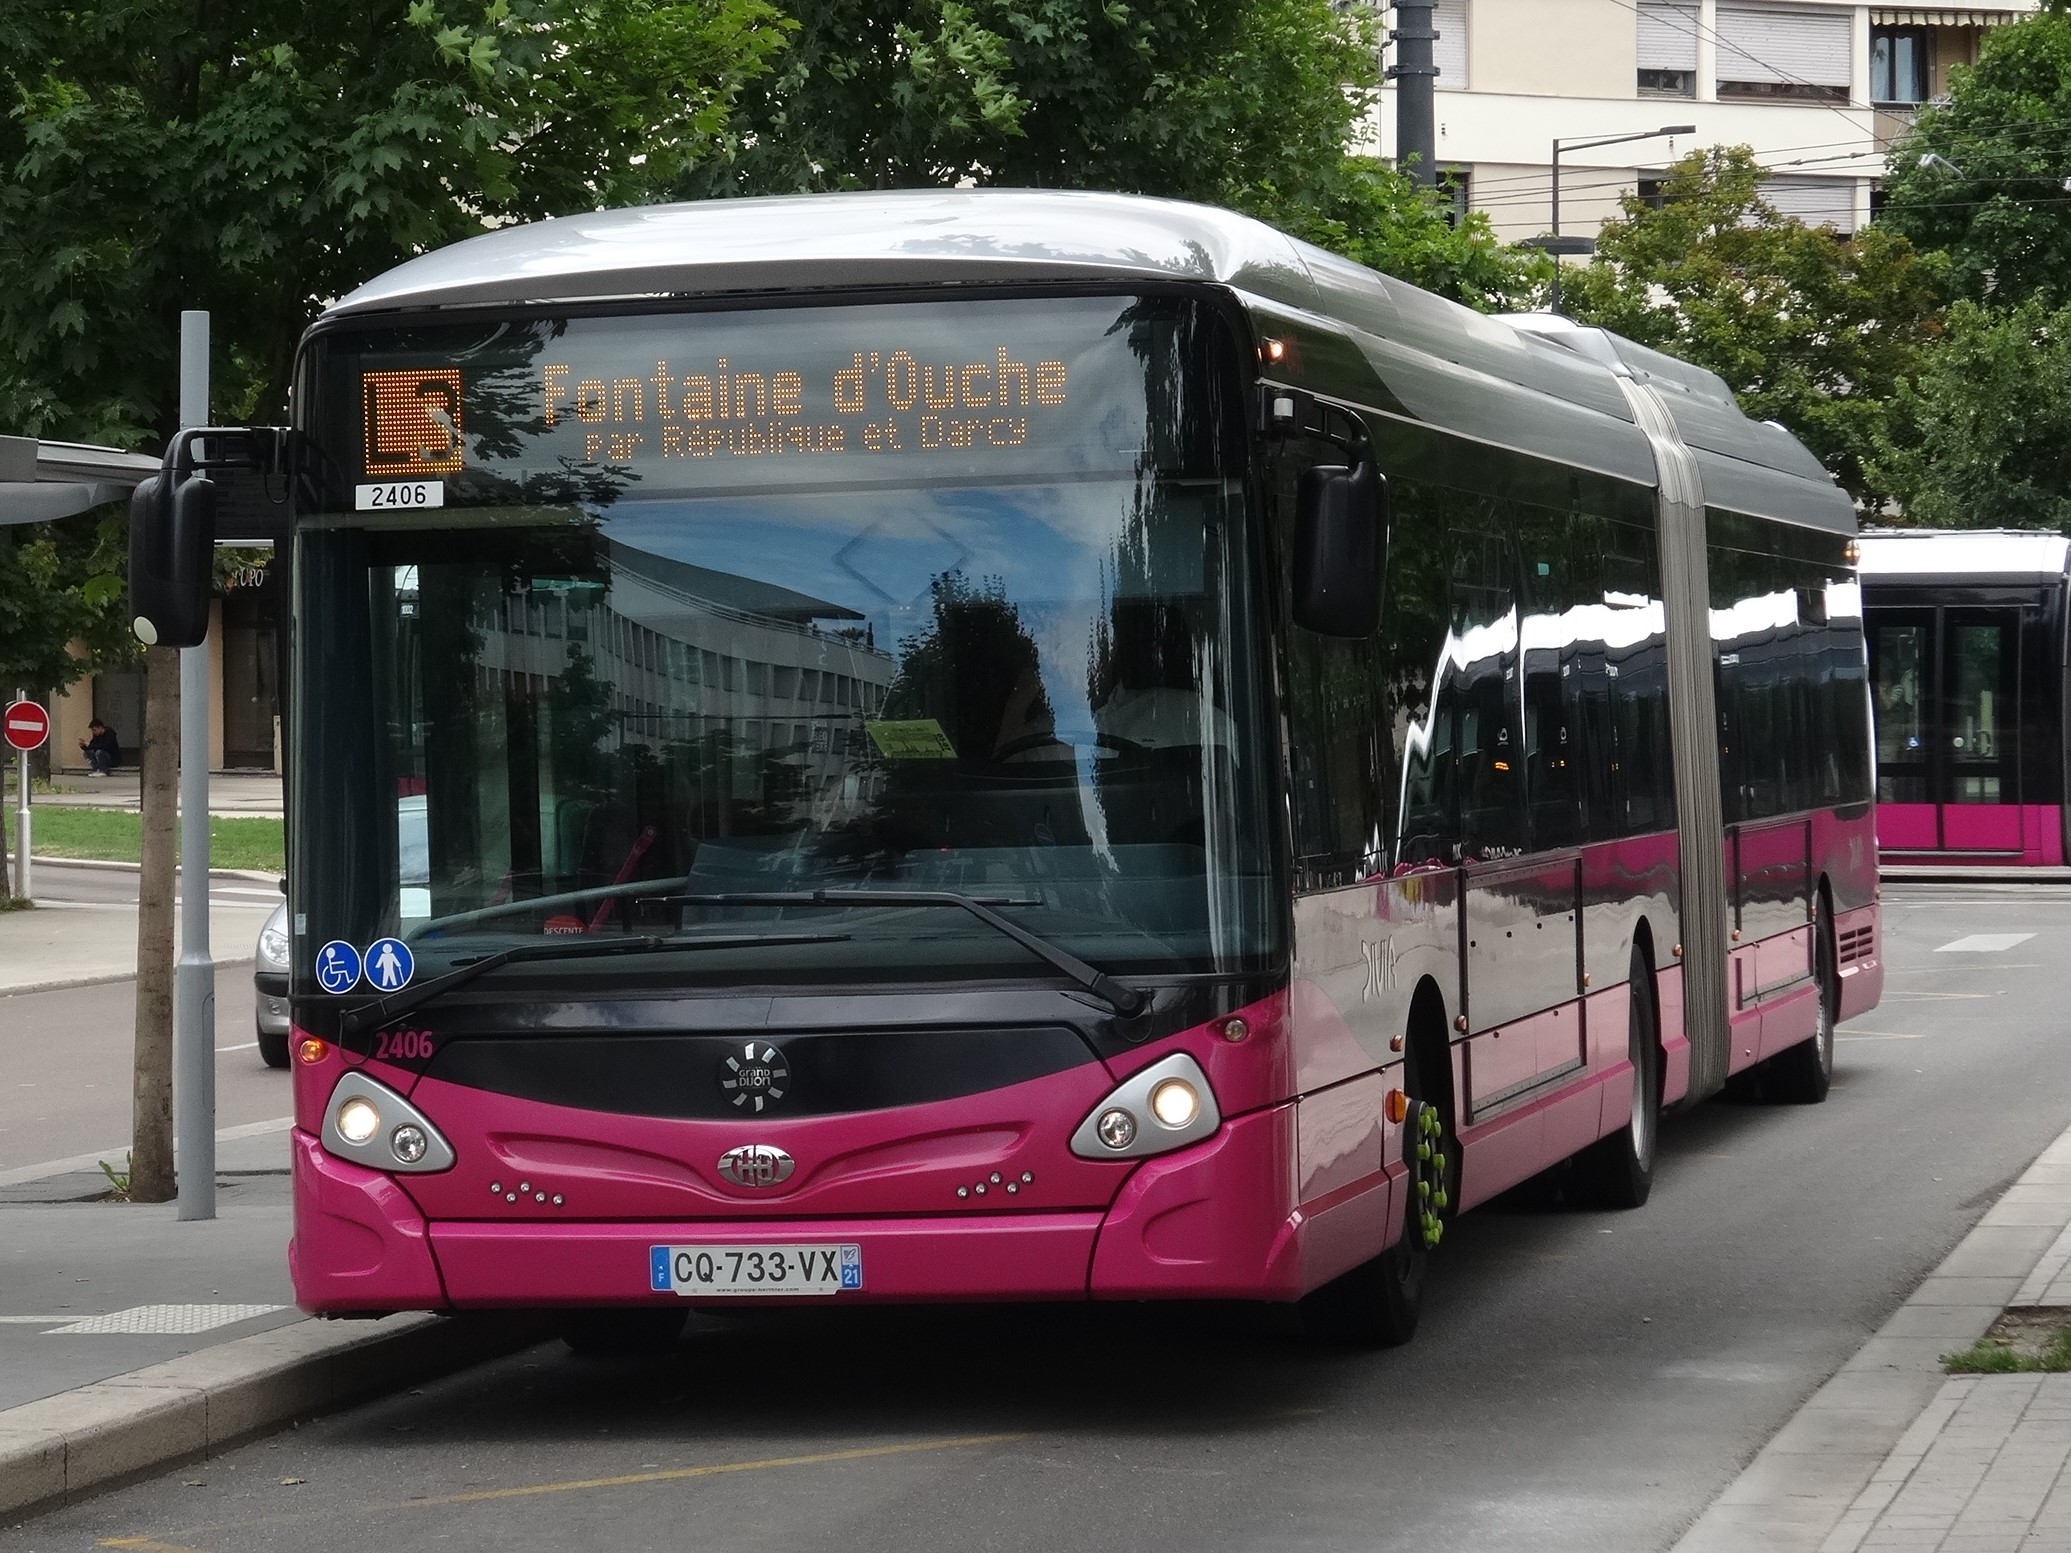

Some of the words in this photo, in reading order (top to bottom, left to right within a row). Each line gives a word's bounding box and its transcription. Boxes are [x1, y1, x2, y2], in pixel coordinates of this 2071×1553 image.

[543, 356, 803, 426] Fontaine
[832, 346, 1067, 413] d'Ouche
[662, 424, 844, 458] République
[863, 416, 902, 449] et
[920, 415, 1026, 449] Darcy
[371, 485, 427, 506] 2406
[376, 1030, 433, 1059] 2406
[658, 1273, 665, 1283] F
[674, 1251, 839, 1284] CQ-733-VX
[844, 1269, 859, 1285] 21
